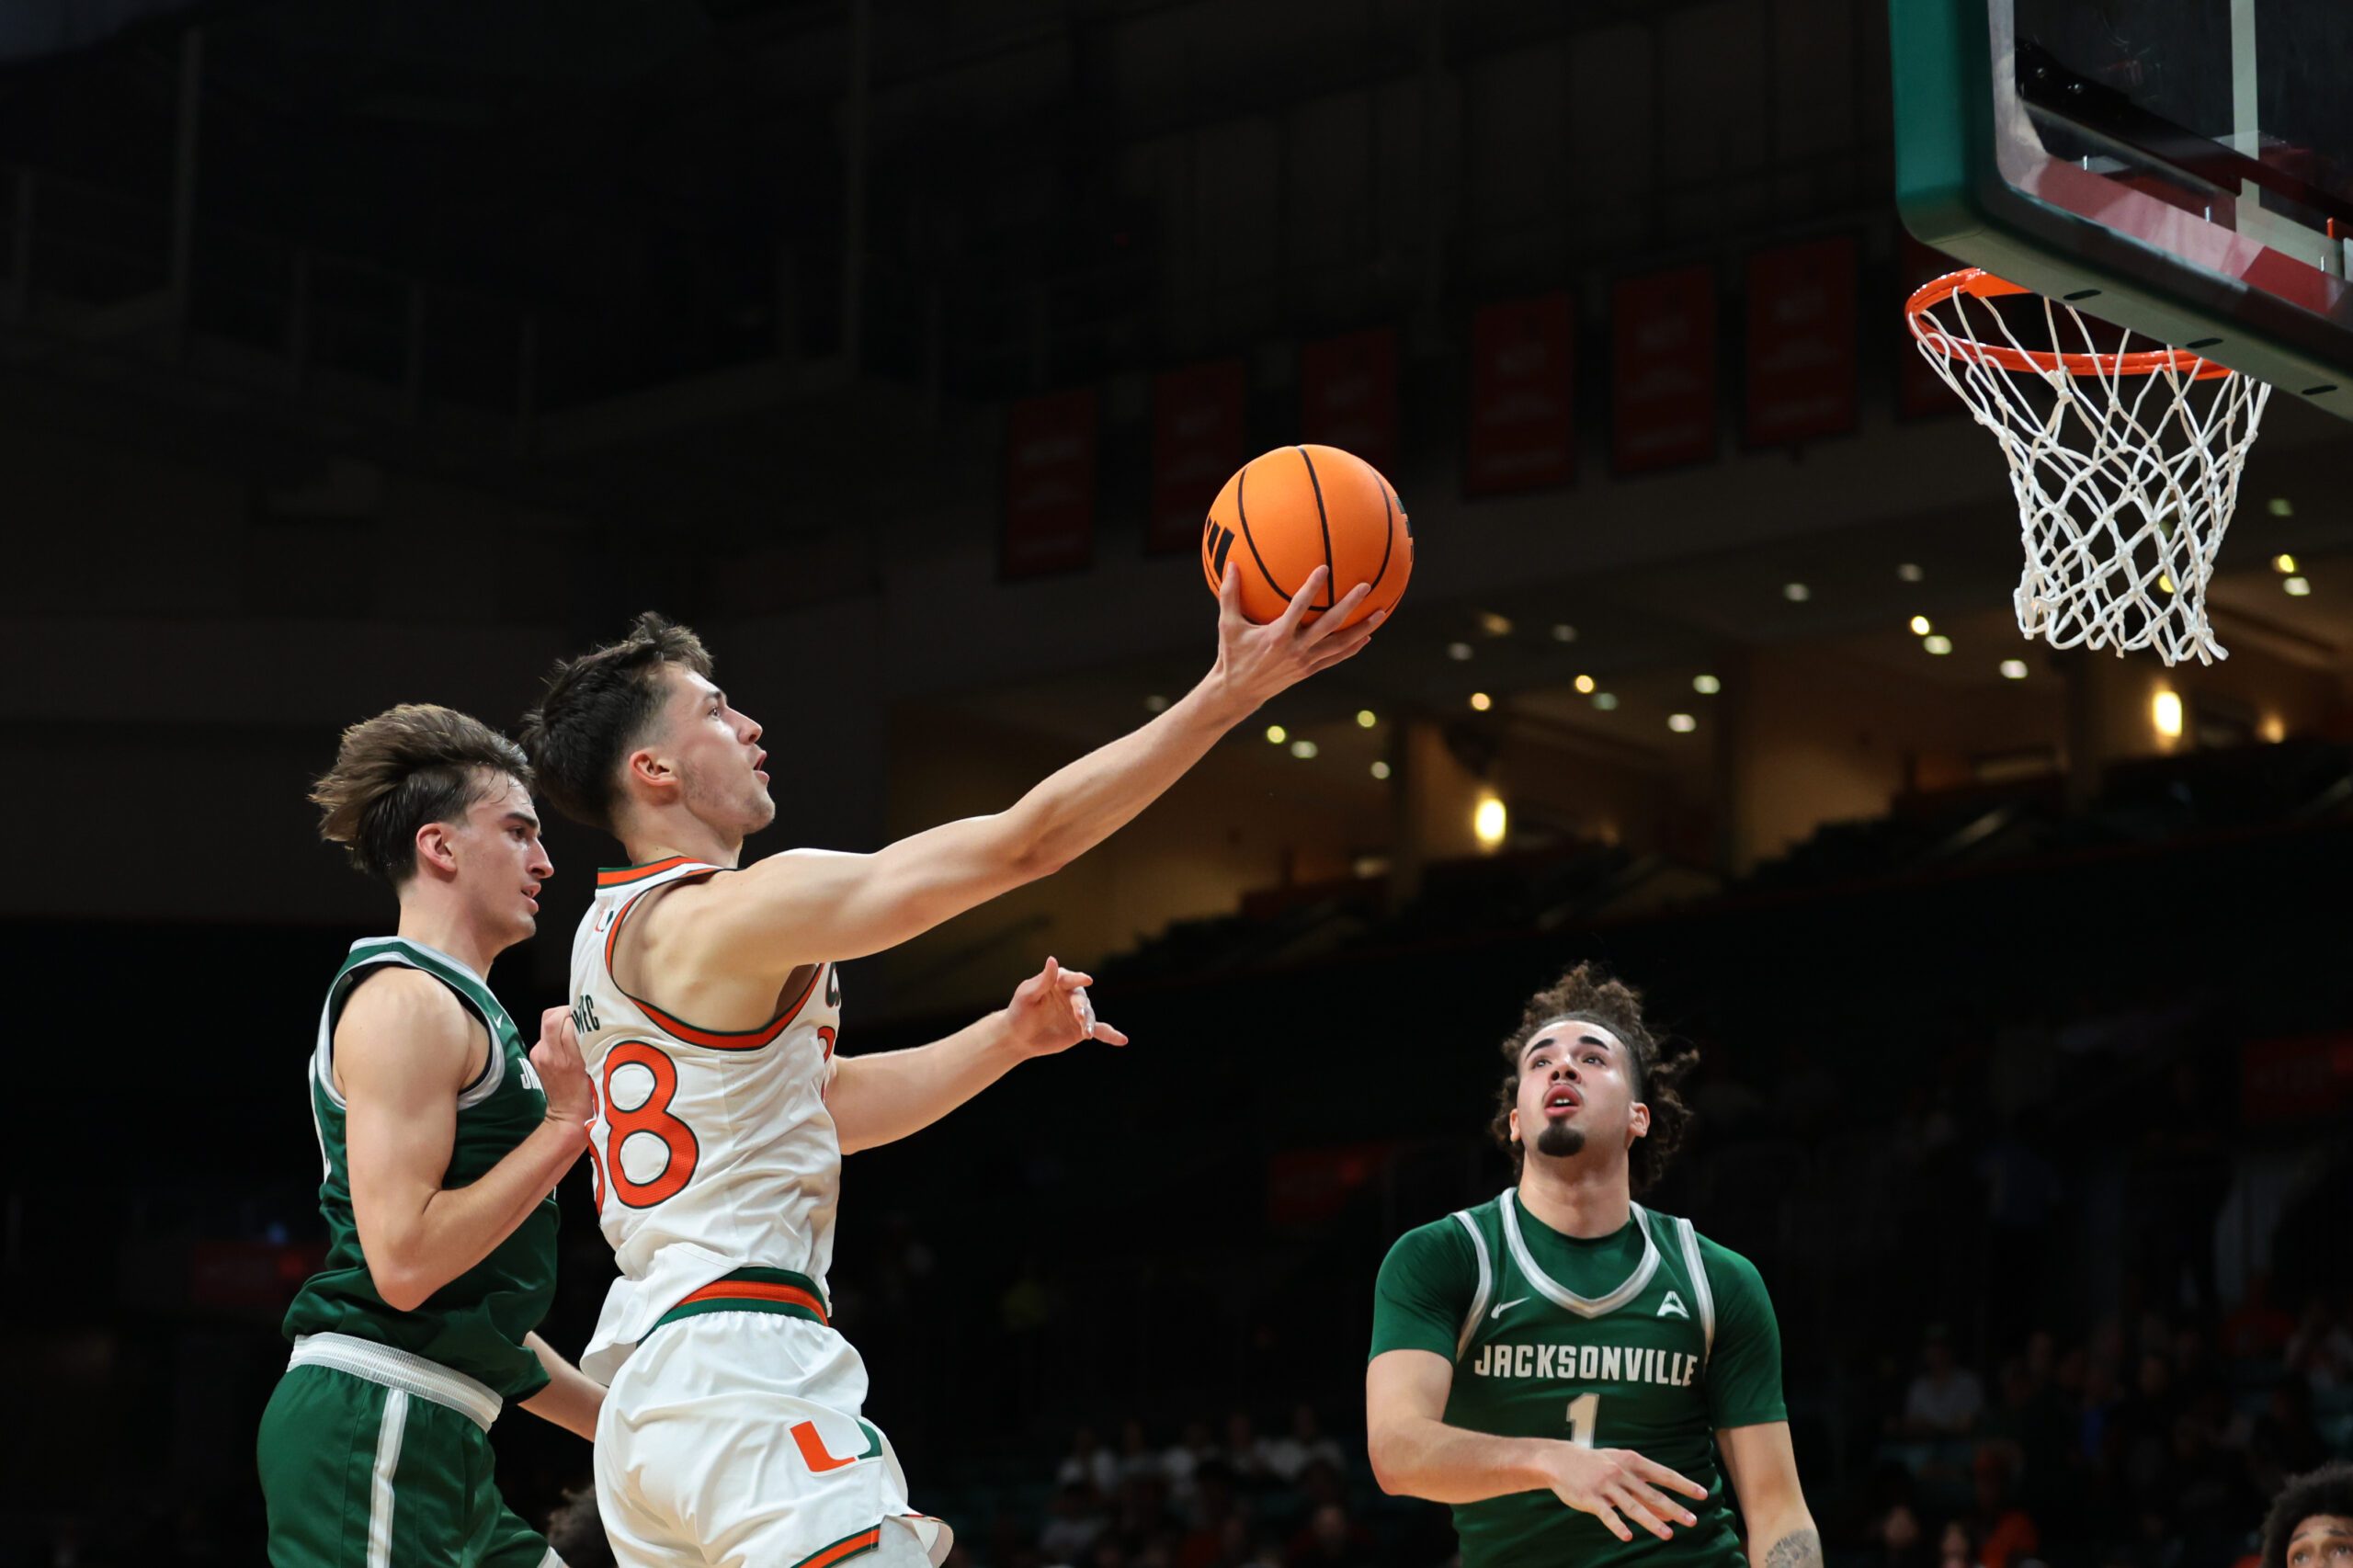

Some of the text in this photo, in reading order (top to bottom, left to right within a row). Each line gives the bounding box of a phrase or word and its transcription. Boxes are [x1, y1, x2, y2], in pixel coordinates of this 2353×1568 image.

[586, 1040, 699, 1217] 8
[1474, 1344, 1699, 1387] JACKSONVILLE
[1565, 1392, 1600, 1449] 1
